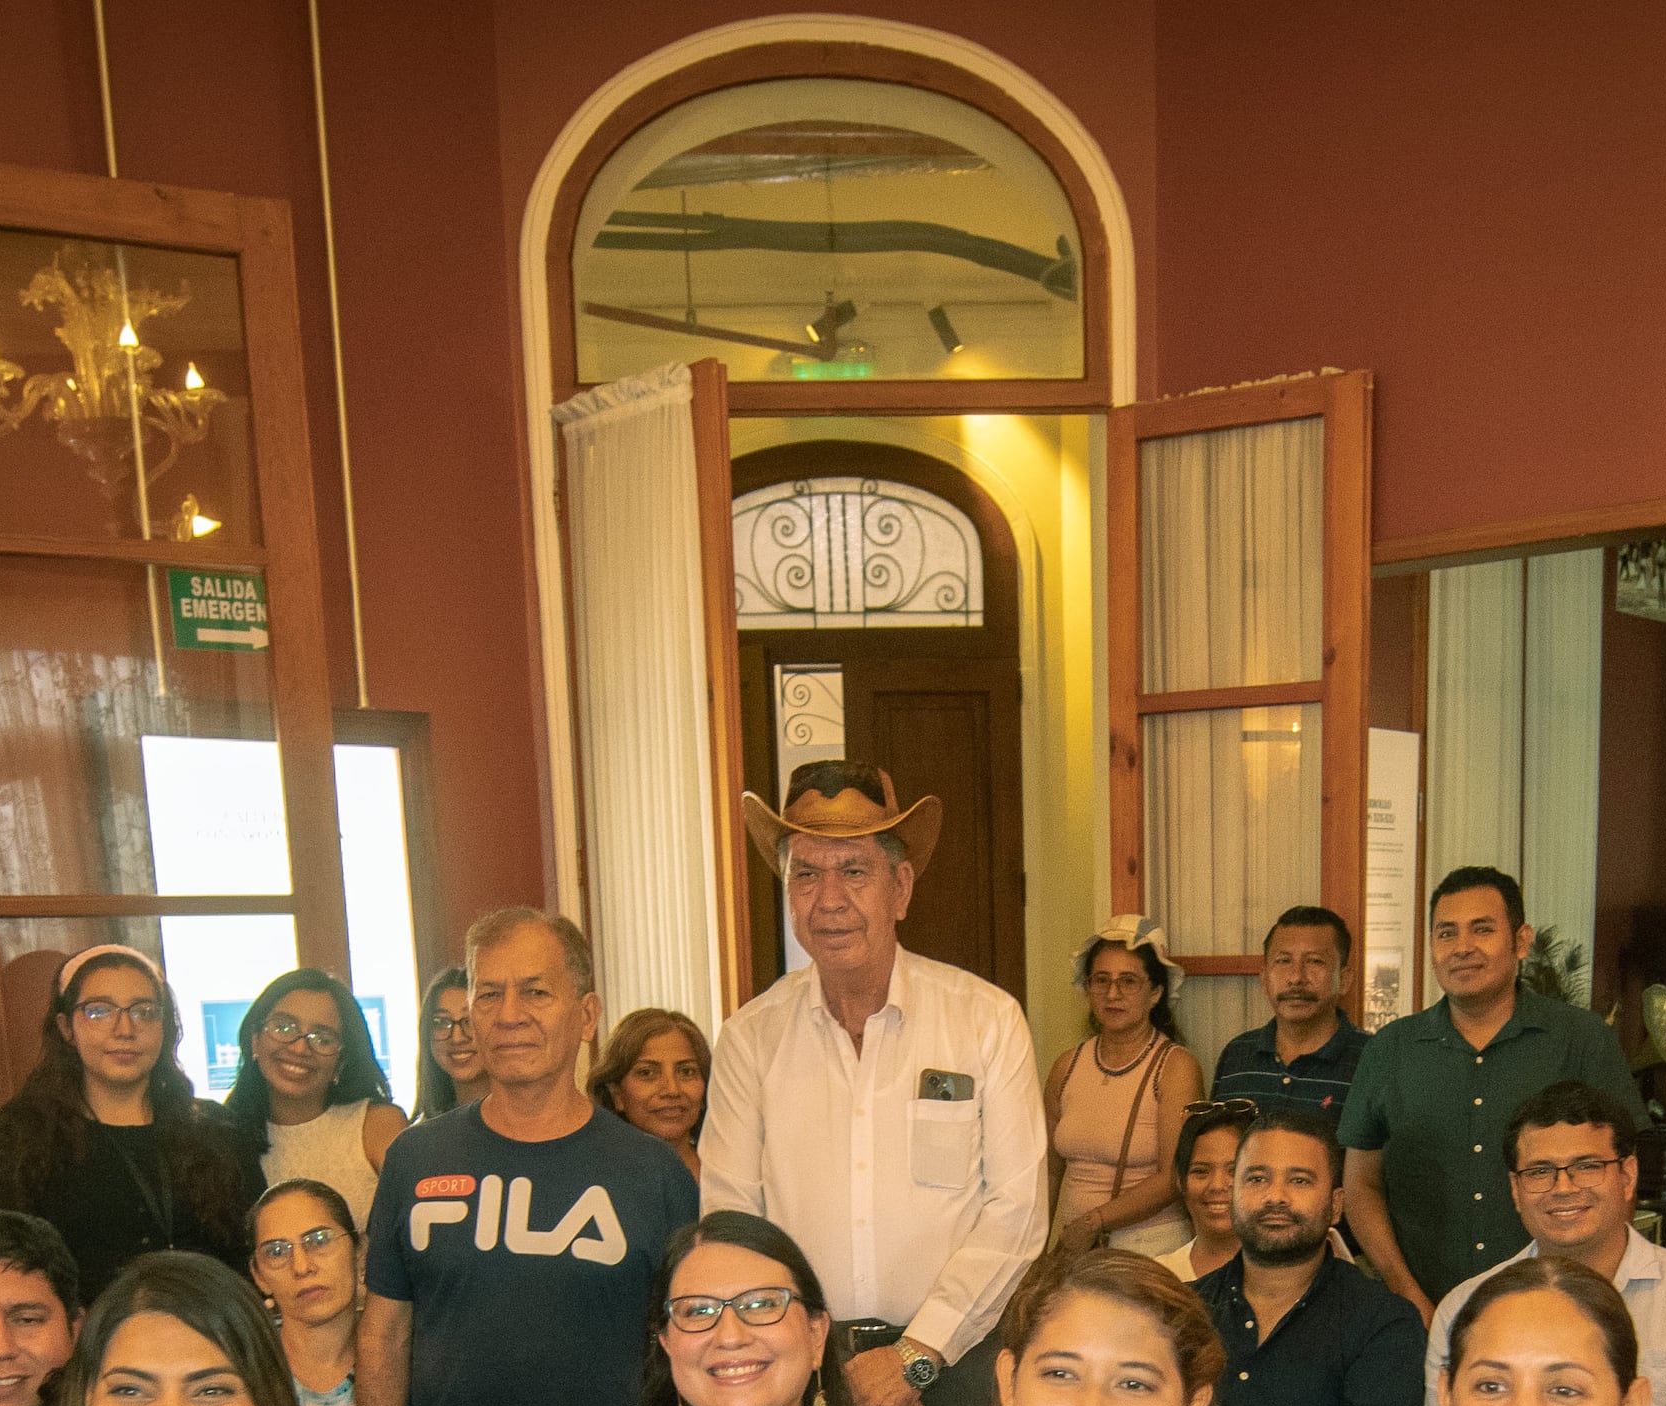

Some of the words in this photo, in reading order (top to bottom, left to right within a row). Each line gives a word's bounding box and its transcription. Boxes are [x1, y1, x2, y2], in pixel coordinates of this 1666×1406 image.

[190, 576, 257, 600] SALIDA
[420, 1178, 468, 1194] SPORT
[409, 1174, 628, 1266] FILA
